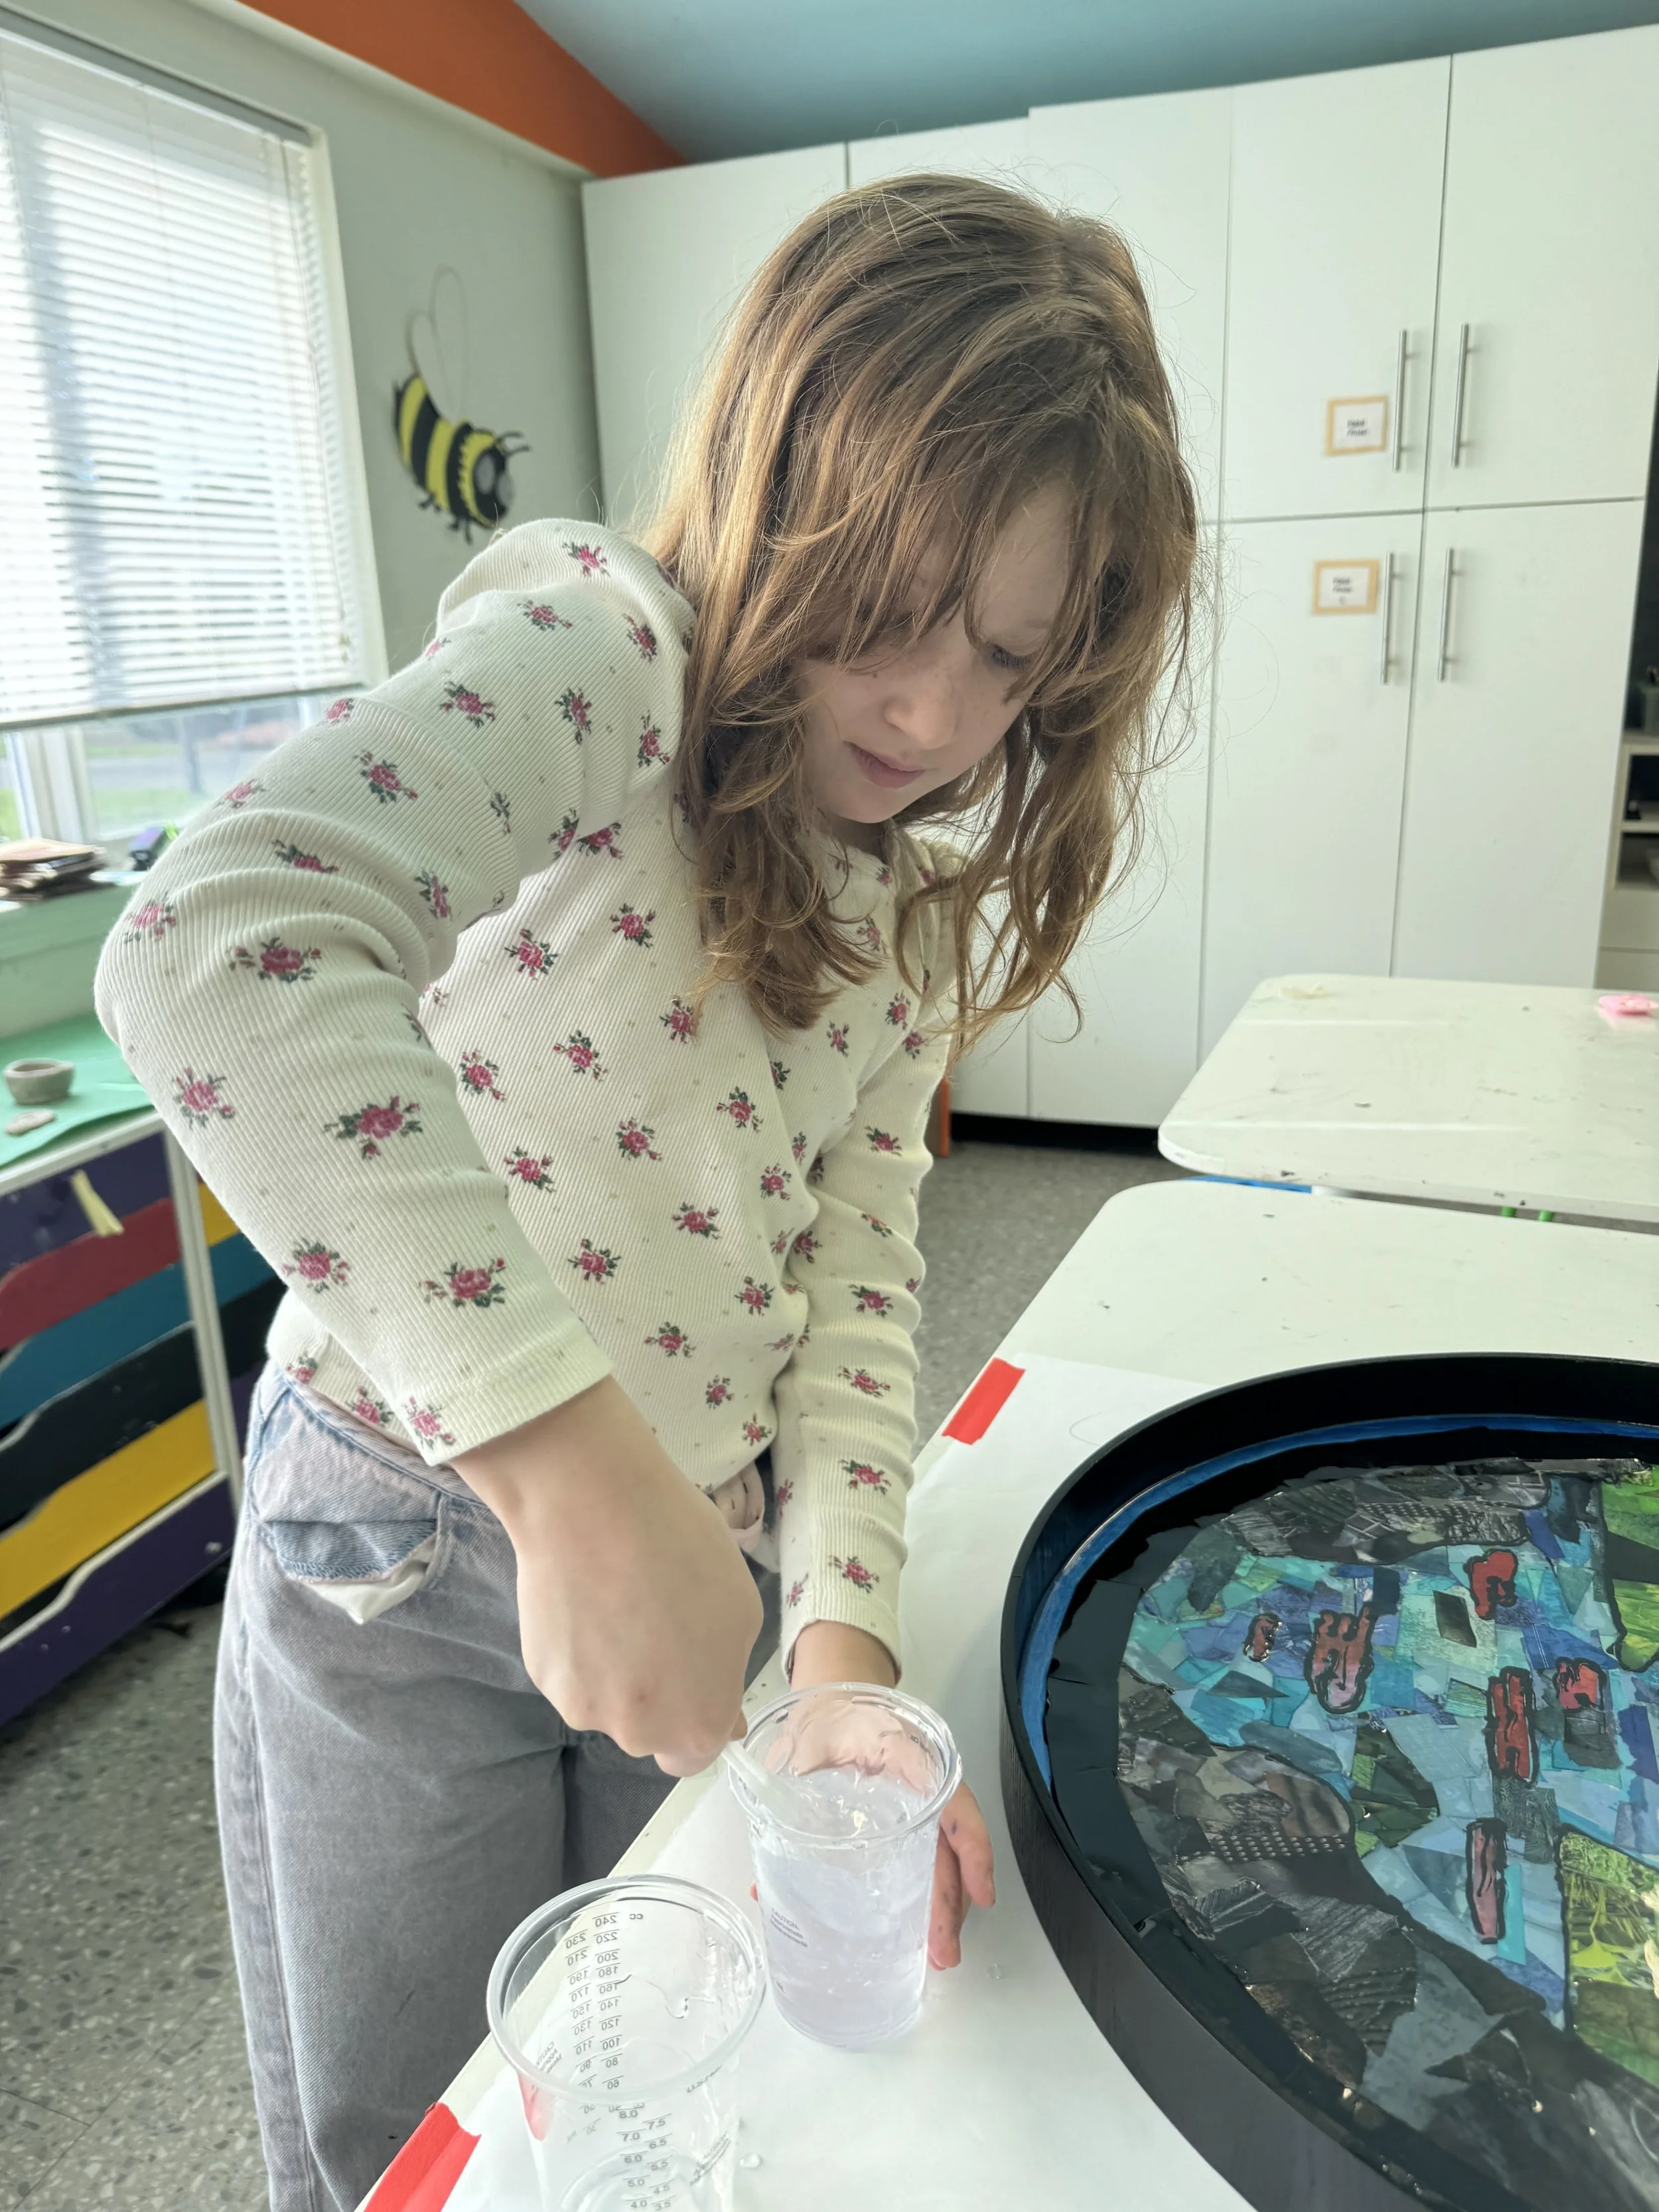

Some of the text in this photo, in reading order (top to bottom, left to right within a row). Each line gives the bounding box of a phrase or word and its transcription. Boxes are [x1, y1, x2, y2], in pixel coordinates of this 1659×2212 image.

[618, 2109, 638, 2119] 8.0
[647, 2117, 666, 2130] 7.5
[622, 2132, 640, 2142] 7.0
[649, 2138, 667, 2149] 6.5
[624, 2154, 642, 2164] 6.0
[651, 2159, 668, 2170] 5.5
[628, 2178, 645, 2187] 5.0
[653, 2183, 670, 2194] 4.5
[630, 2199, 647, 2209] 4.0
[655, 2199, 671, 2211] 3.5
